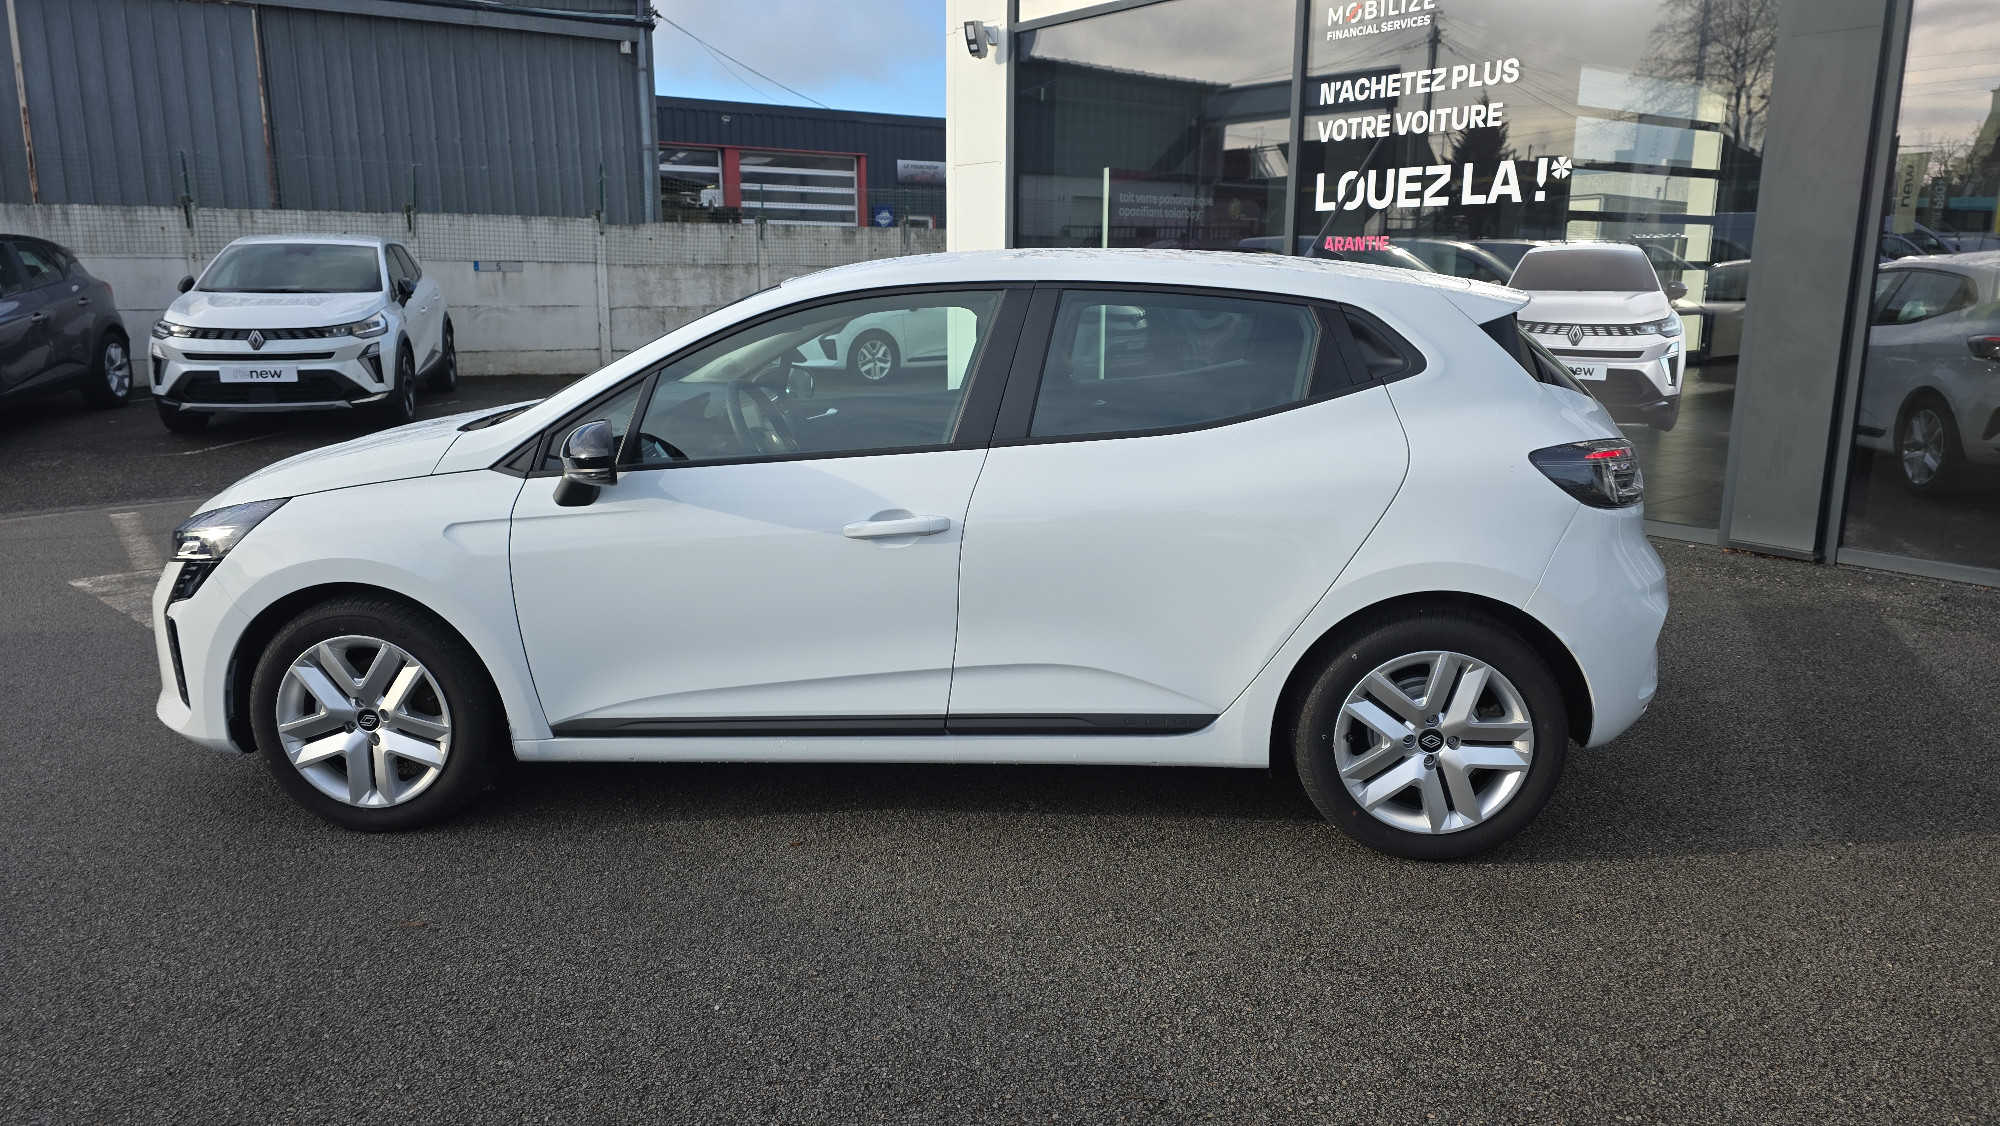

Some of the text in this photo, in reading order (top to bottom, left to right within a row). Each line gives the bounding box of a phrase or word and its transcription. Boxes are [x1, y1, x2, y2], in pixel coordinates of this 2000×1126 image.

[1326, 15, 1431, 41] FINANCIAL SERVICES
[1319, 58, 1520, 105] N'ACHETEZ PLUS
[1318, 102, 1504, 143] VOTRE VOITURE
[1120, 192, 1134, 203] toit
[1314, 164, 1452, 212] LOUEZ
[1461, 160, 1522, 205] LA
[1324, 235, 1390, 252] ARANTIE
